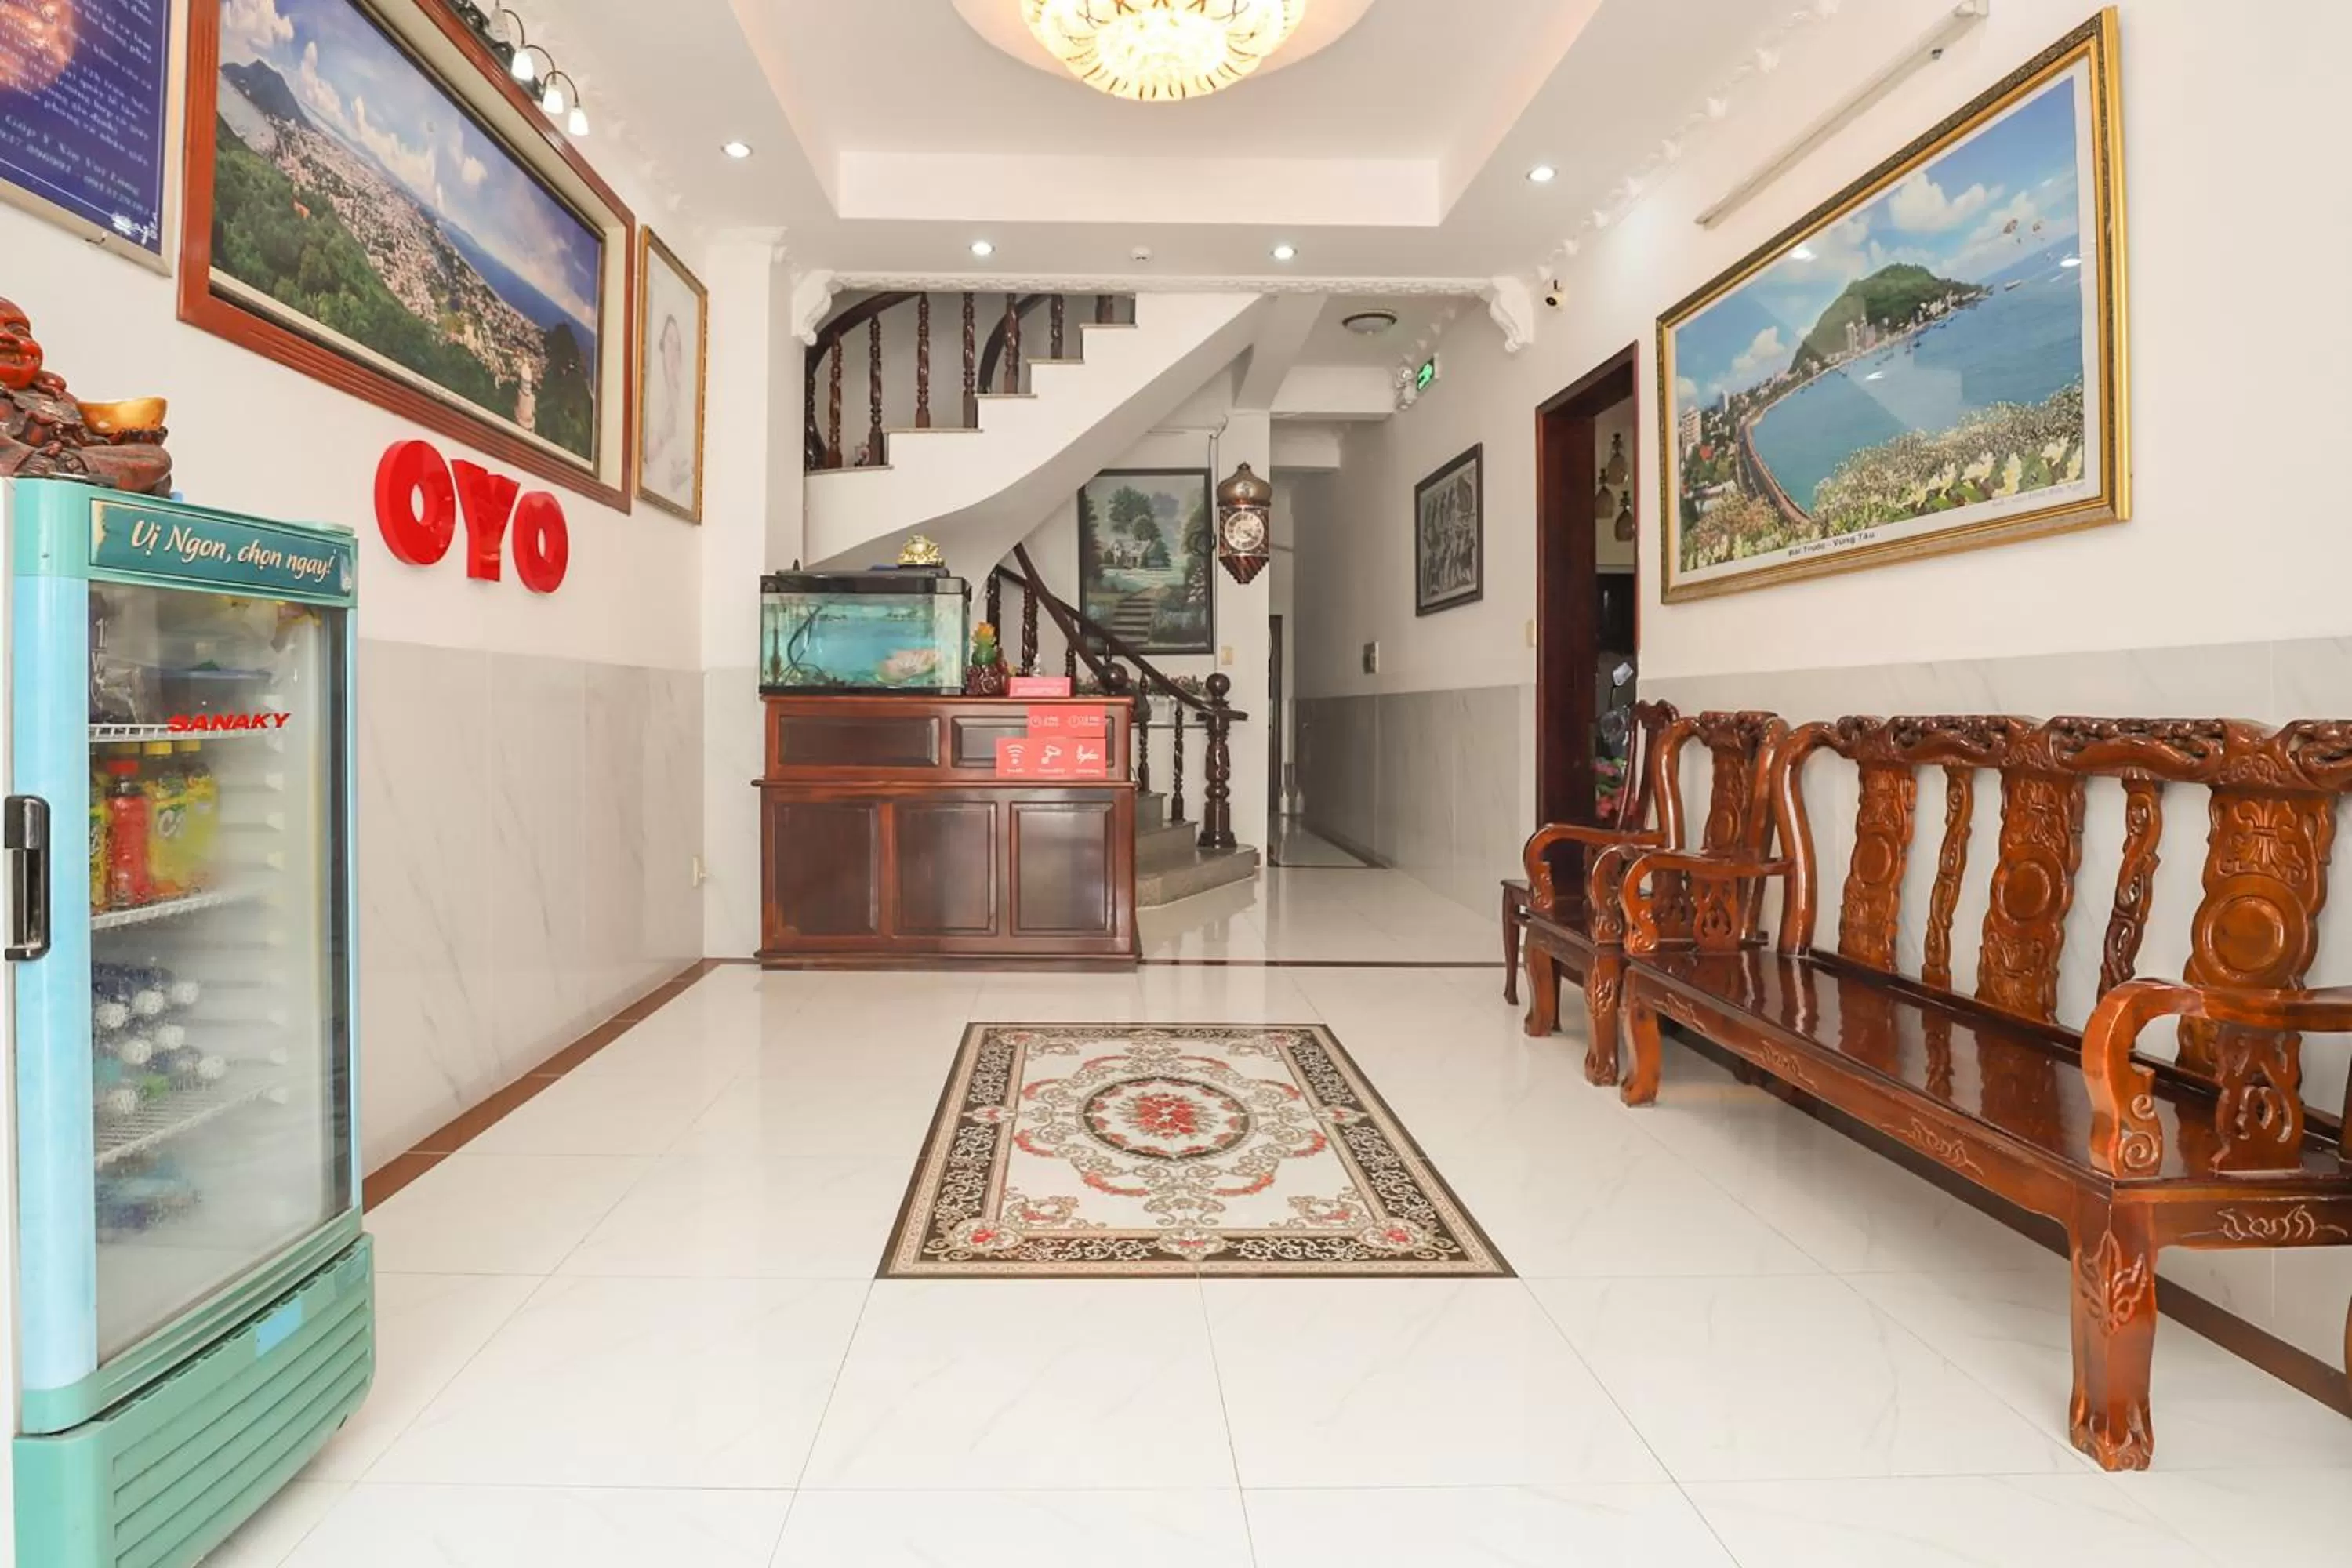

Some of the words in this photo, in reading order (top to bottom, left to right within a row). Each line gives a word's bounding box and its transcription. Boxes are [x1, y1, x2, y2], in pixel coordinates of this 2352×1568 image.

[374, 439, 568, 594] OYO
[131, 519, 162, 557] Vị
[164, 523, 232, 564] Ngon,
[238, 539, 281, 571] chọn
[285, 548, 337, 583] ngay!
[165, 712, 292, 733] SANAKY
